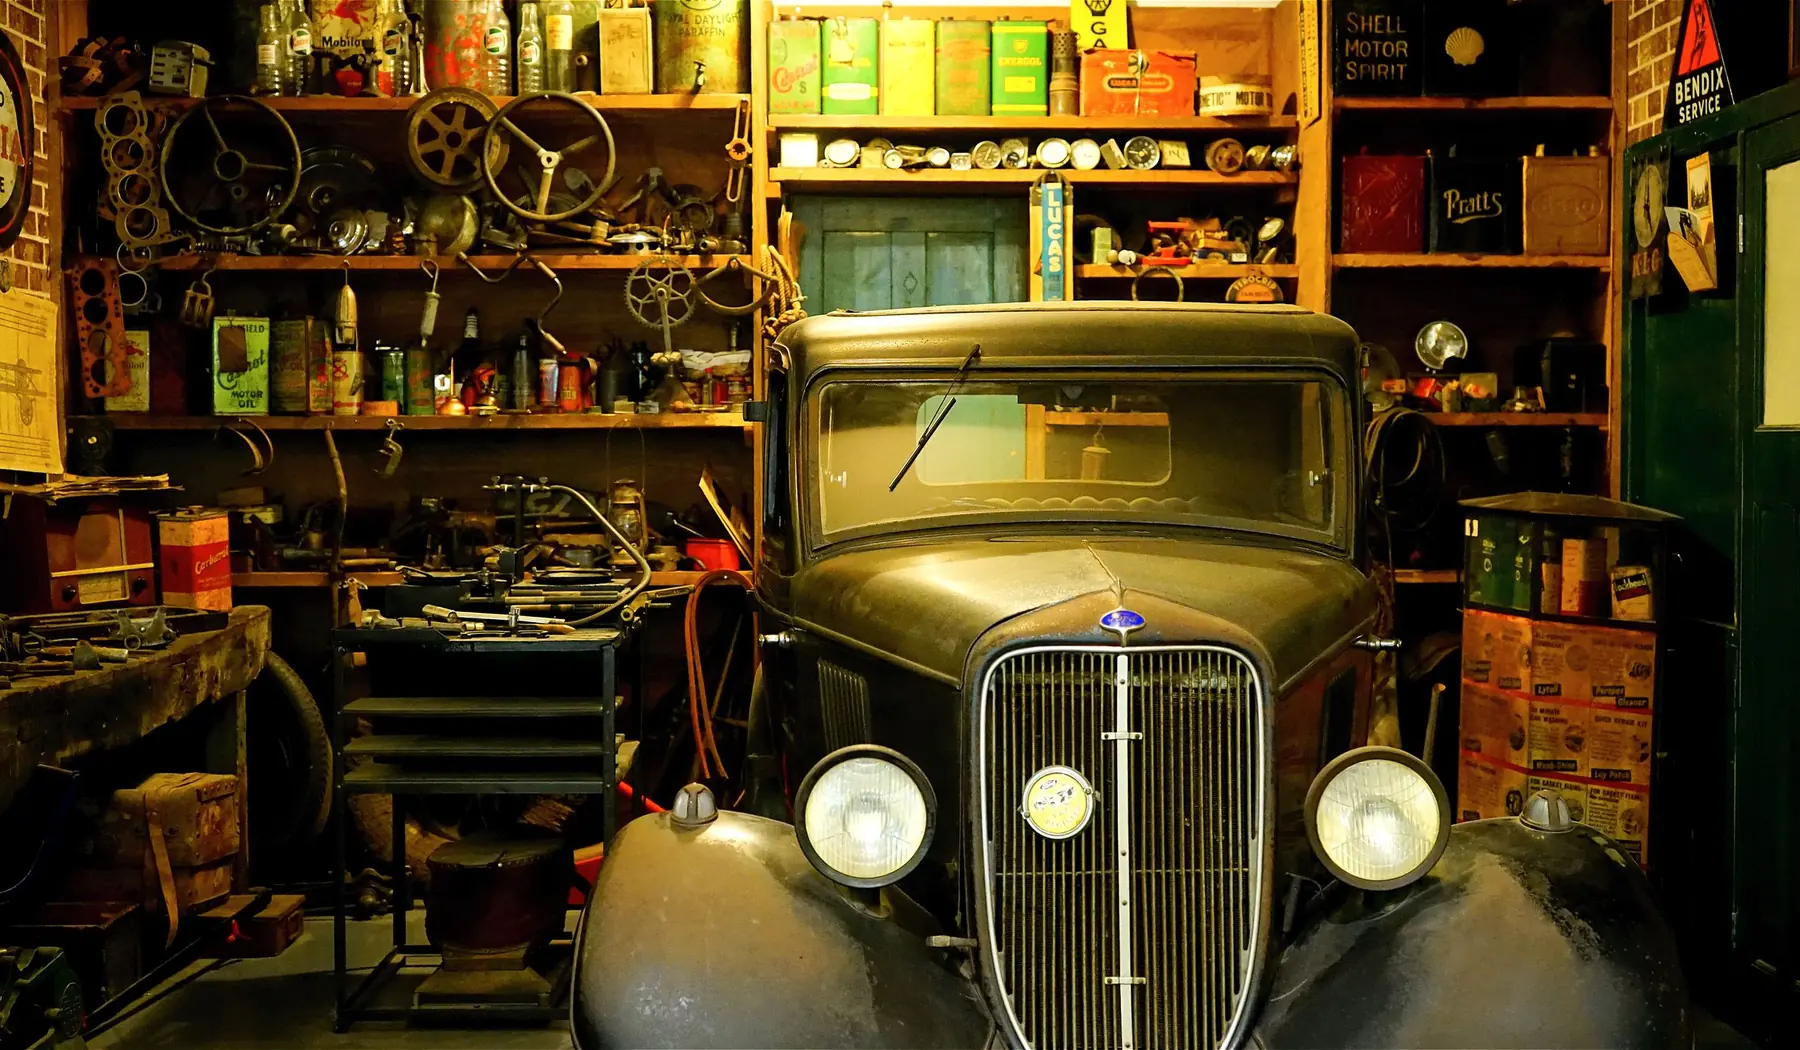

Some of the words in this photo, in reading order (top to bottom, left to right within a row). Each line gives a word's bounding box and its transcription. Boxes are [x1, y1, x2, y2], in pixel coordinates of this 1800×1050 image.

[679, 27, 725, 37] PARAFFIN
[1346, 12, 1407, 34] SHELL
[1345, 39, 1408, 60] MOTOR
[998, 57, 1042, 67] ENERGOL
[1345, 61, 1407, 81] SPIRIT
[1675, 66, 1724, 105] BENDIX
[1236, 91, 1264, 106] MOTOR
[1679, 94, 1721, 124] SERVICE
[1443, 188, 1504, 222] Pratts
[1047, 190, 1062, 273] LUCAS
[231, 390, 263, 399] MOTOR
[238, 400, 257, 409] OIL
